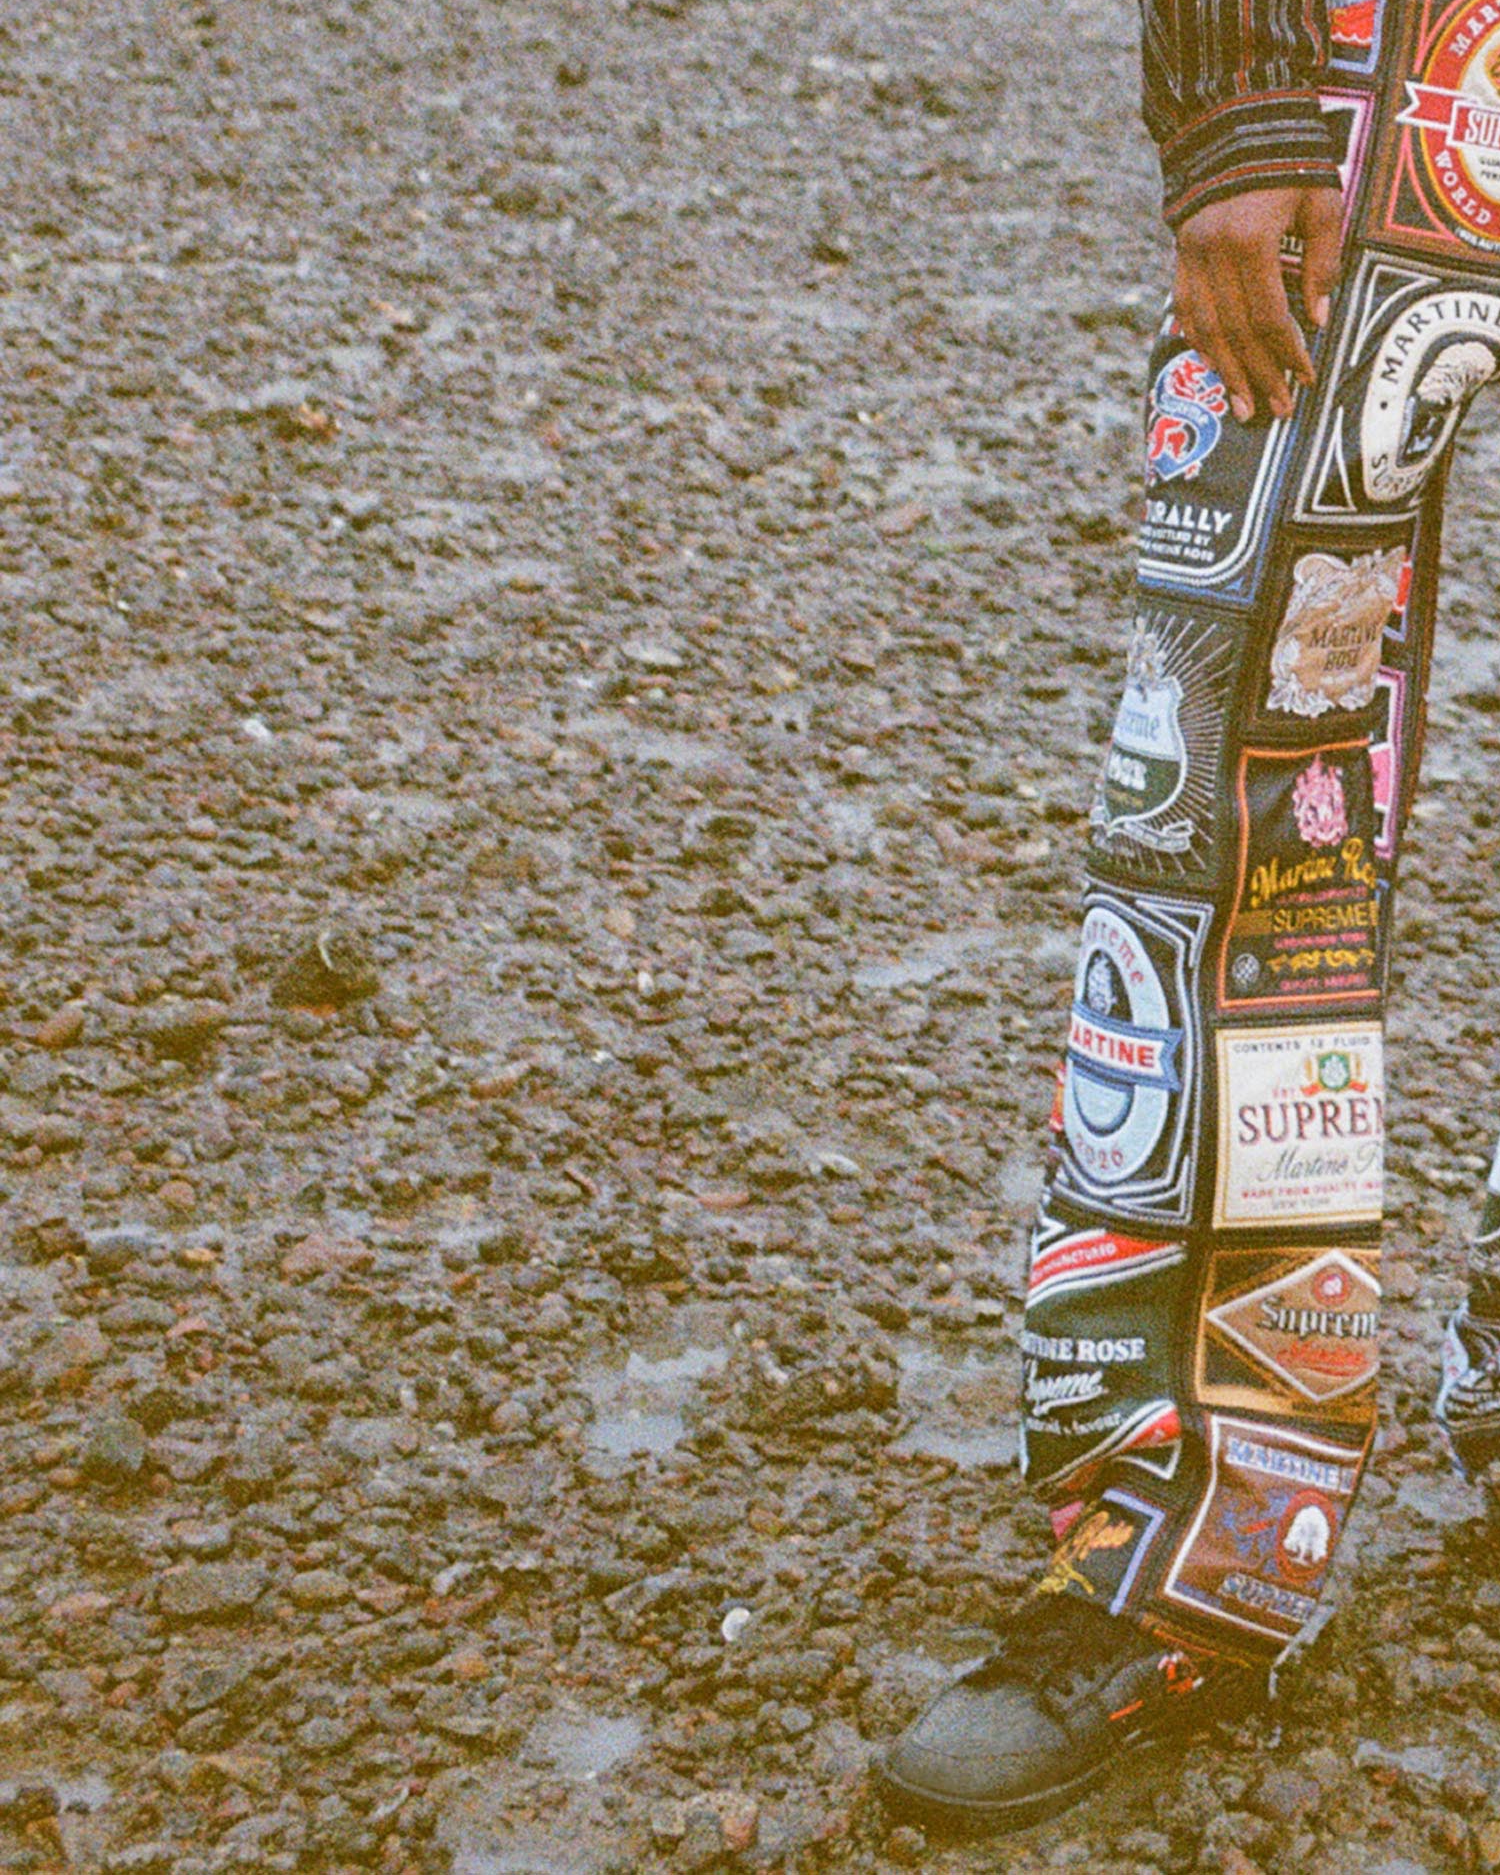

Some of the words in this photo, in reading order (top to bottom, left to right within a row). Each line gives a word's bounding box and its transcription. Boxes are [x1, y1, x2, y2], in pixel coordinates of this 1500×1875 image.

[1435, 149, 1492, 225] WORLD
[1072, 1025, 1155, 1068] ARTINE
[1233, 1040, 1300, 1053] CONTENTS
[1333, 1036, 1370, 1047] FLUID
[1075, 1336, 1147, 1363] ROSE
